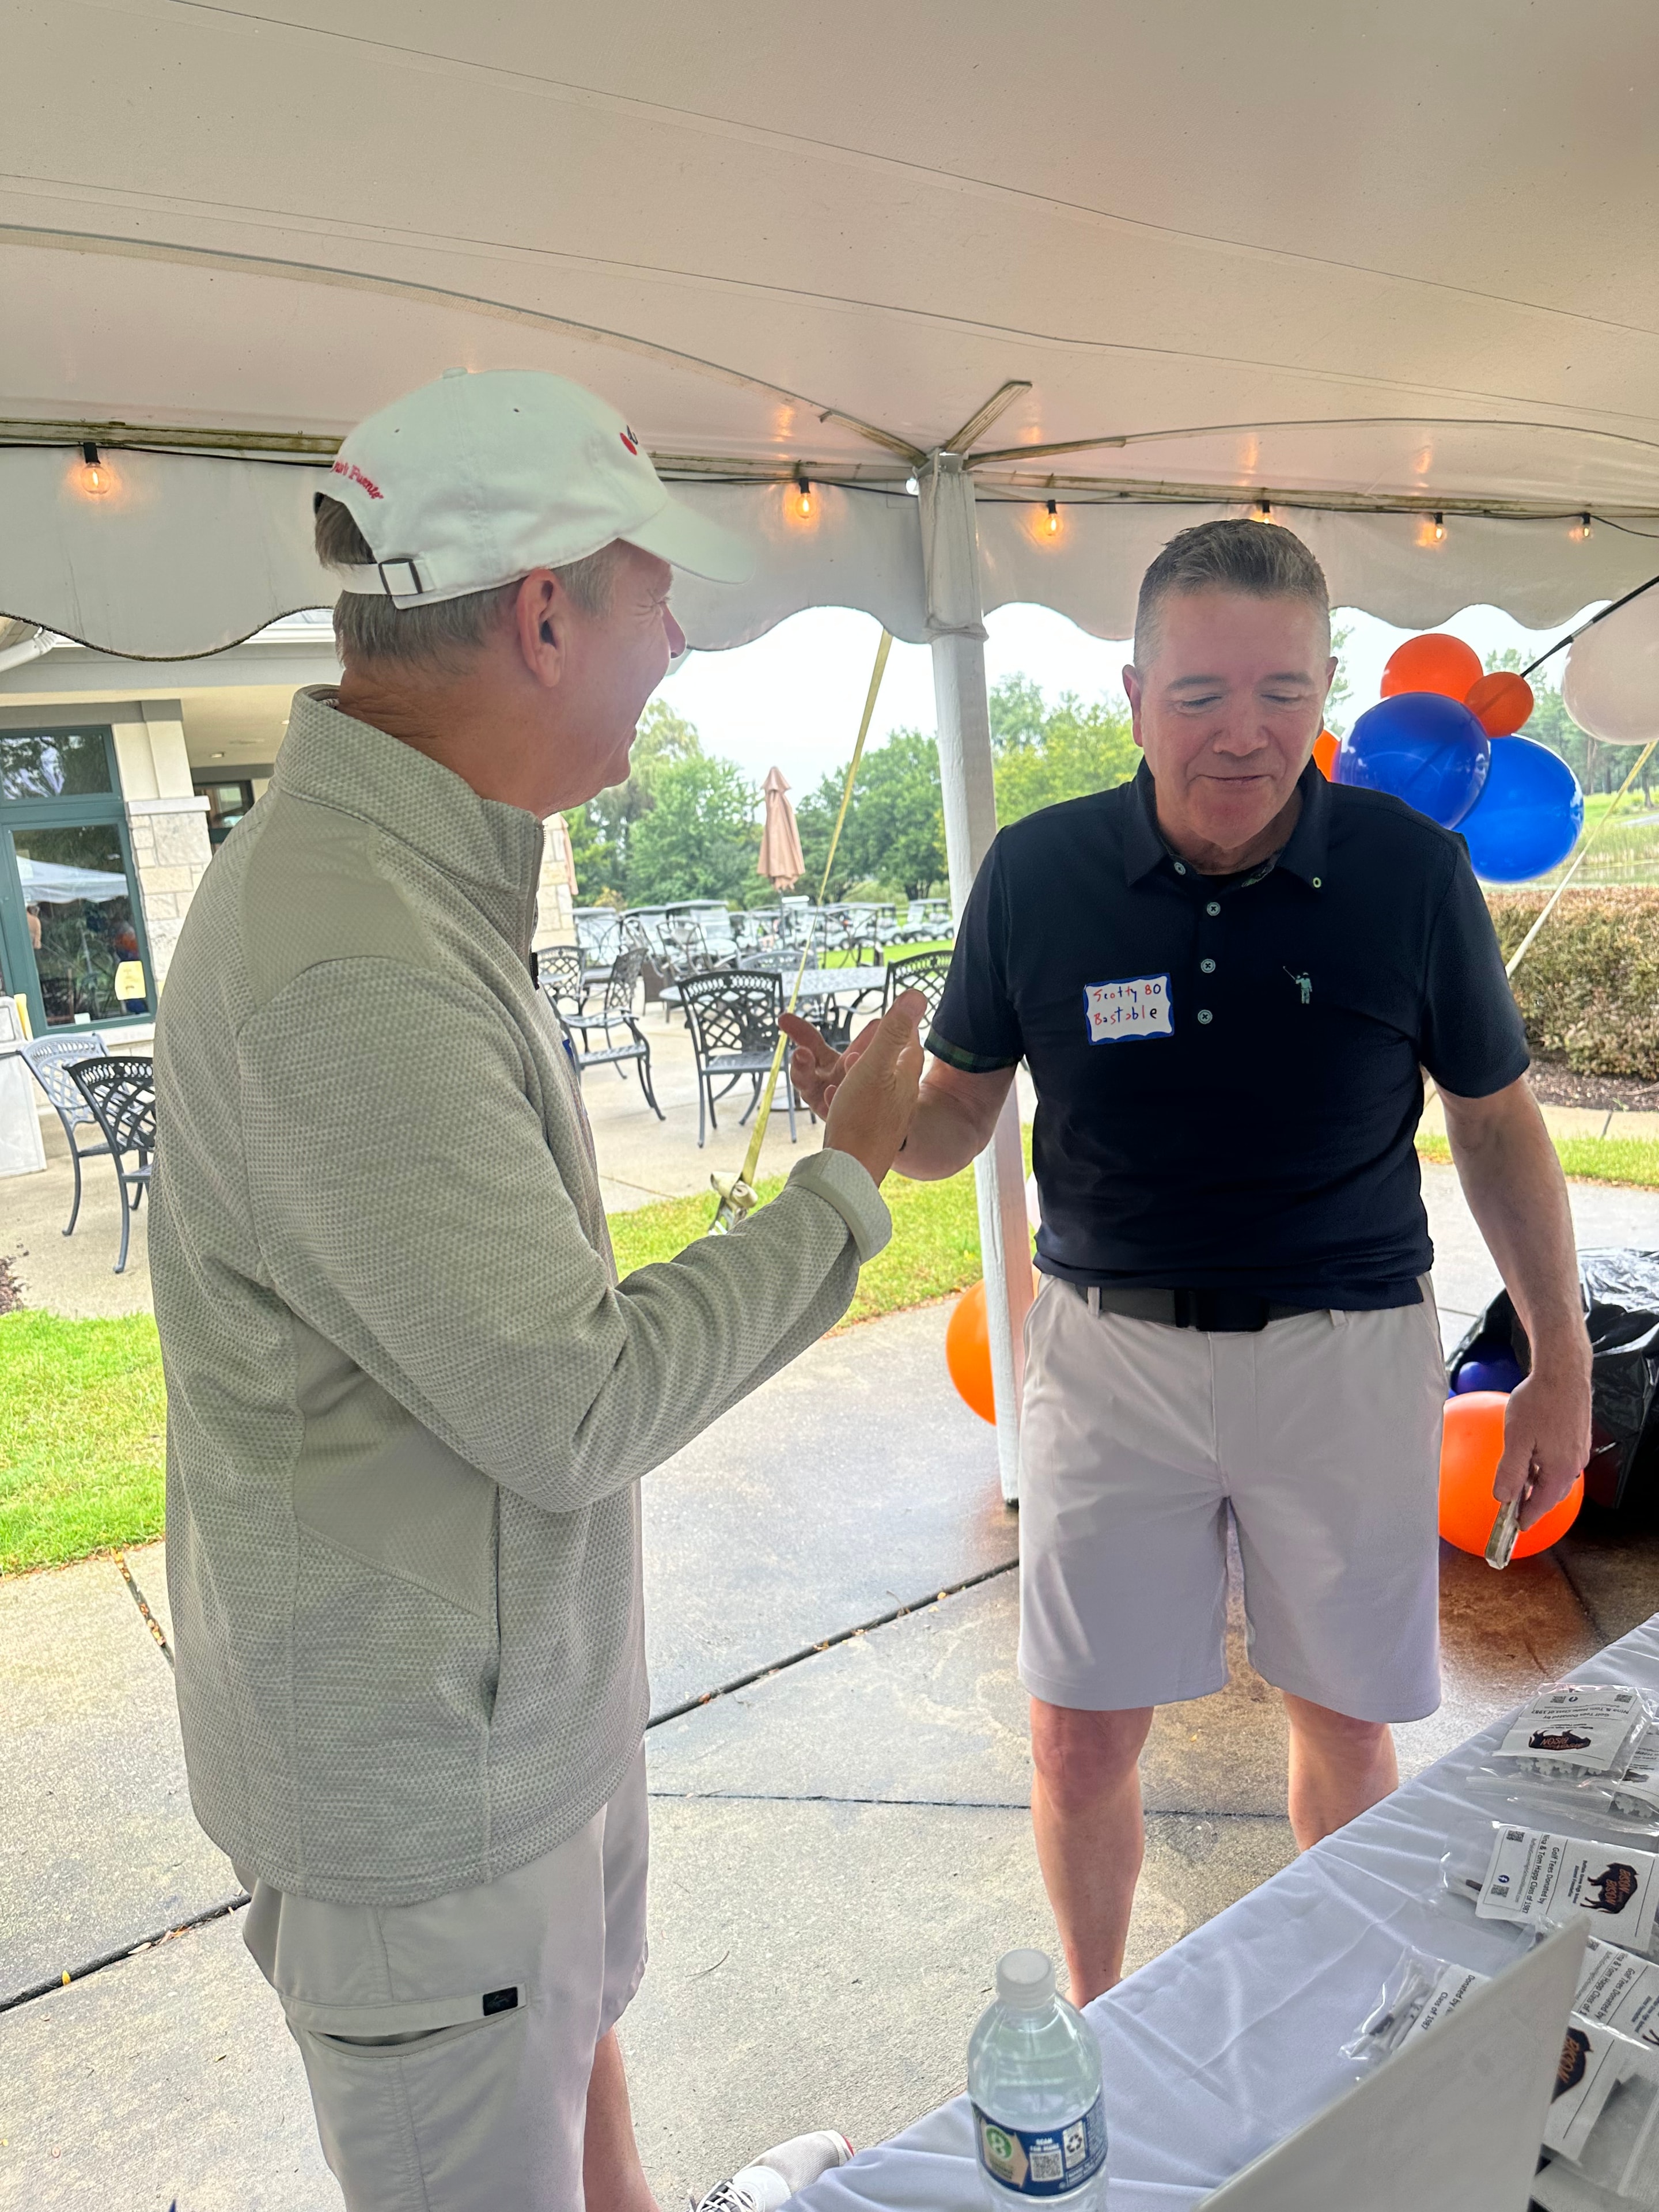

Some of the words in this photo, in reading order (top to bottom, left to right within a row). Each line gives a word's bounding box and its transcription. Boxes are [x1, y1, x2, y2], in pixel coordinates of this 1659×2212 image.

[1093, 986, 1137, 1003] Scotty
[1094, 1005, 1157, 1025] Bastable
[1536, 1852, 1545, 1864] Tom
[1551, 1847, 1559, 1859] Golf
[1531, 1865, 1541, 1880] Happ
[1548, 1861, 1556, 1873] Tees
[1528, 1881, 1537, 1895] Class
[1541, 1874, 1553, 1897] Donated
[1522, 1902, 1531, 1914] 1987
[1605, 1966, 1618, 1977] Tom
[1624, 1968, 1635, 1980] Golf
[1456, 1975, 1475, 1999] Donated
[1595, 1977, 1609, 1990] Happ
[1616, 1978, 1628, 1990] Tees
[1434, 1992, 1448, 2006] Class
[1449, 1998, 1460, 2007] by
[1587, 1991, 1600, 2004] Class
[1601, 1989, 1620, 2013] Donated
[1431, 2007, 1437, 2016] of
[1582, 2003, 1590, 2012] of
[1595, 2012, 1606, 2020] by
[1421, 2016, 1434, 2030] 1987
